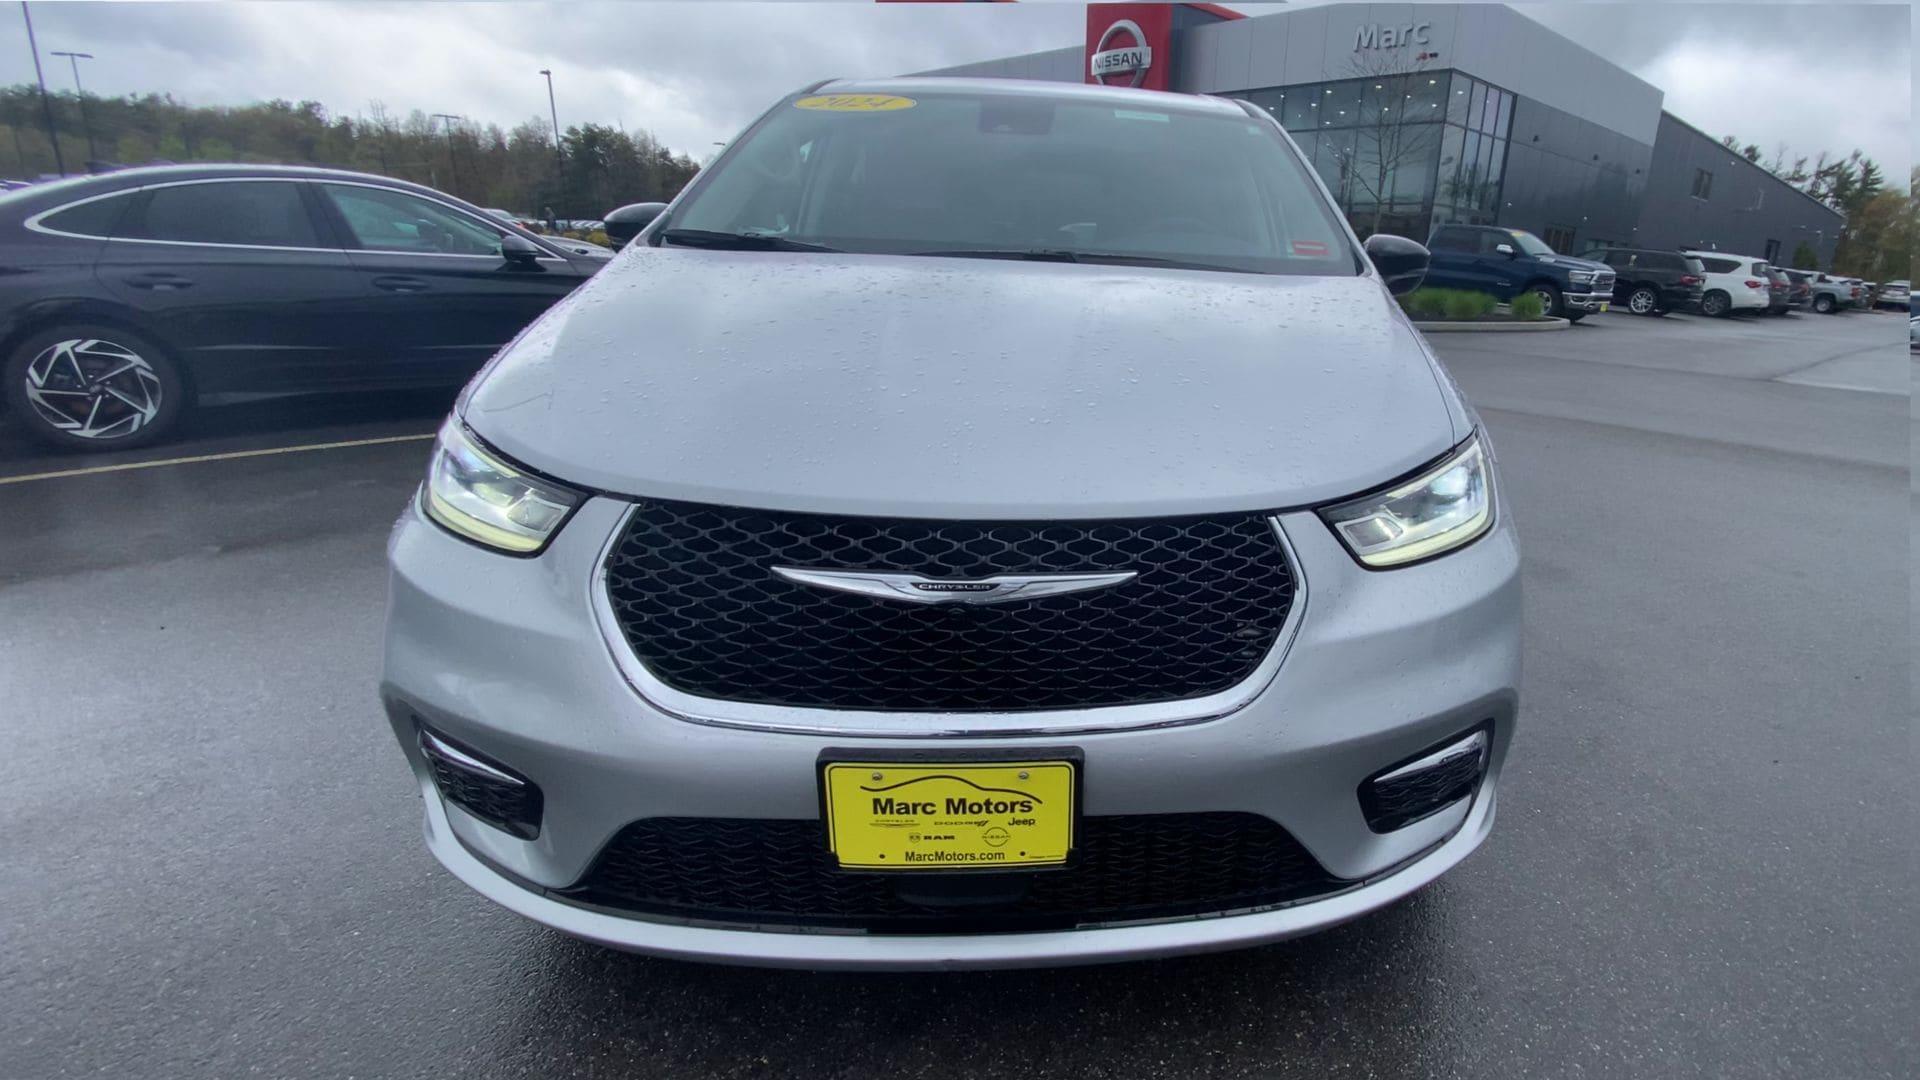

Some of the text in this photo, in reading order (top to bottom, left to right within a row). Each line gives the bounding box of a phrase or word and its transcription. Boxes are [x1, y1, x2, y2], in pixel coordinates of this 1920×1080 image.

[1353, 22, 1431, 53] Marc
[1095, 51, 1143, 69] NISSAN
[872, 797, 1033, 815] Marc Motors
[1008, 817, 1036, 826] Jeep
[905, 851, 1005, 862] MarcMotors.com
